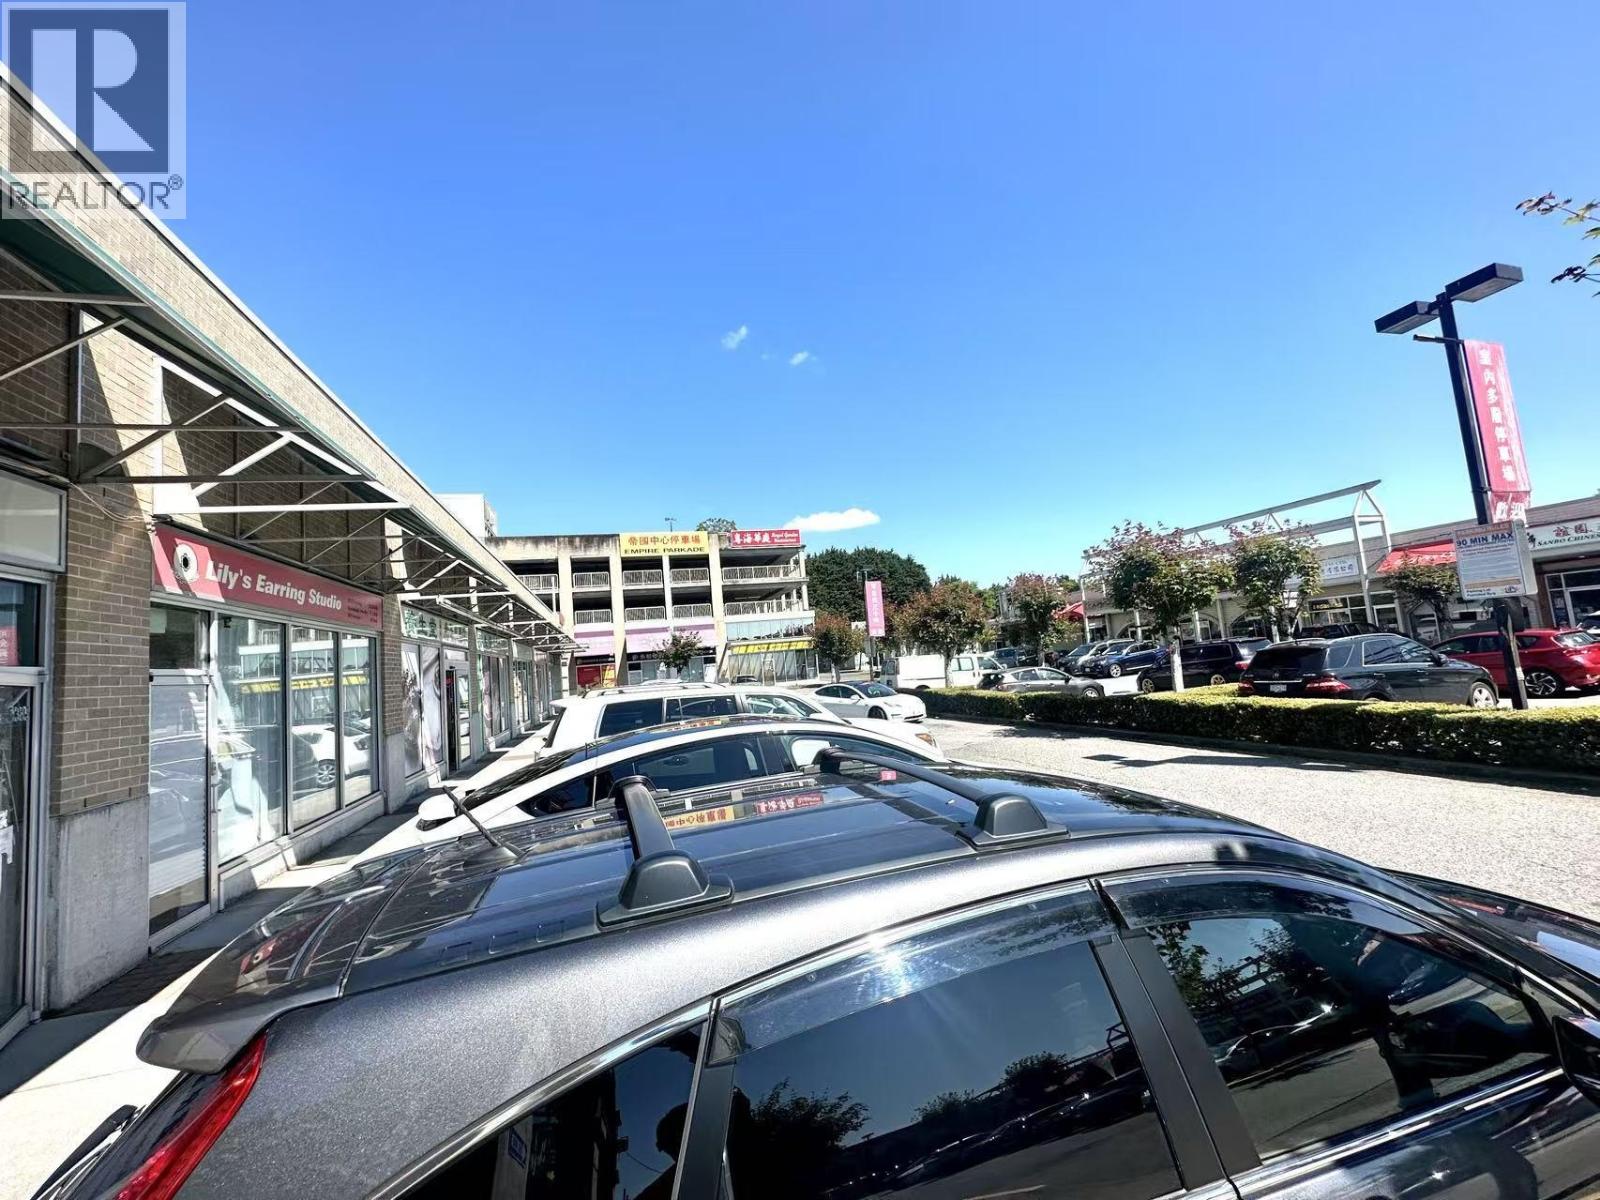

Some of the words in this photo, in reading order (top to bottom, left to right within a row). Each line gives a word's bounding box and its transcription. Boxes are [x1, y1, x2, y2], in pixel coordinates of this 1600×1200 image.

[1456, 538, 1467, 547] 90
[1470, 535, 1488, 545] MIN
[1491, 532, 1514, 543] MAX
[205, 560, 252, 590] Lily's
[256, 573, 306, 605] Earring
[309, 588, 342, 610] Studio
